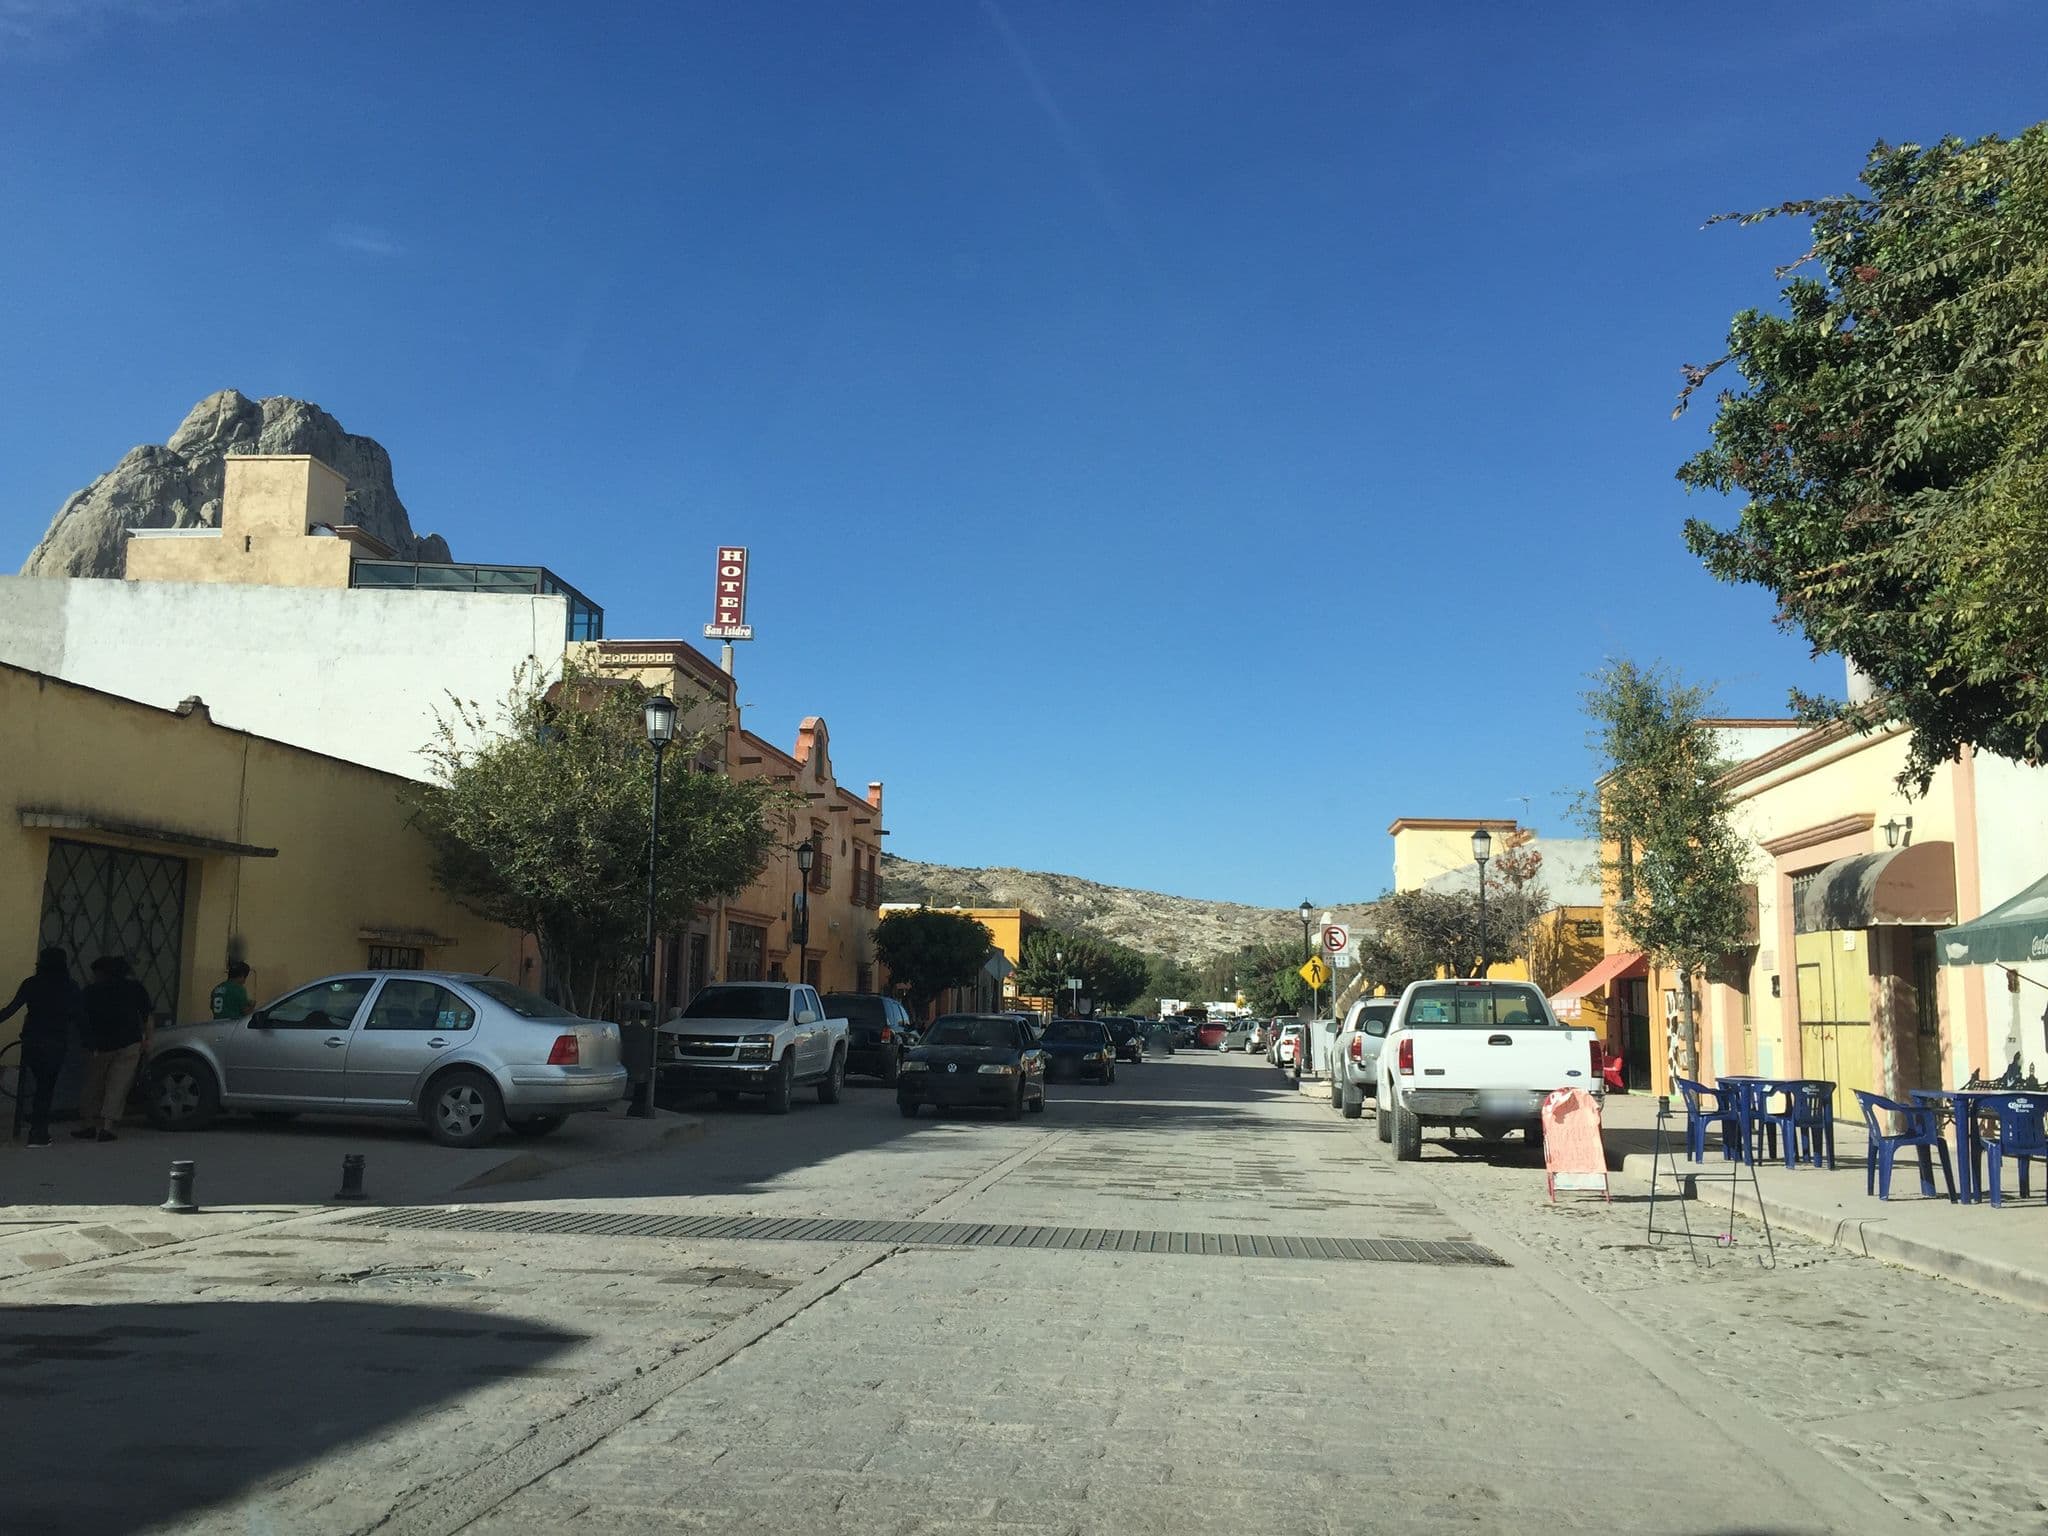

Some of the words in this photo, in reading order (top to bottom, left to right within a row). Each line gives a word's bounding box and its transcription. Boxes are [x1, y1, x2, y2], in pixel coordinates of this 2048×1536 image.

[719, 550, 743, 624] HOTEL
[705, 625, 722, 636] San
[723, 625, 751, 637] Isidro
[214, 997, 223, 1013] 9
